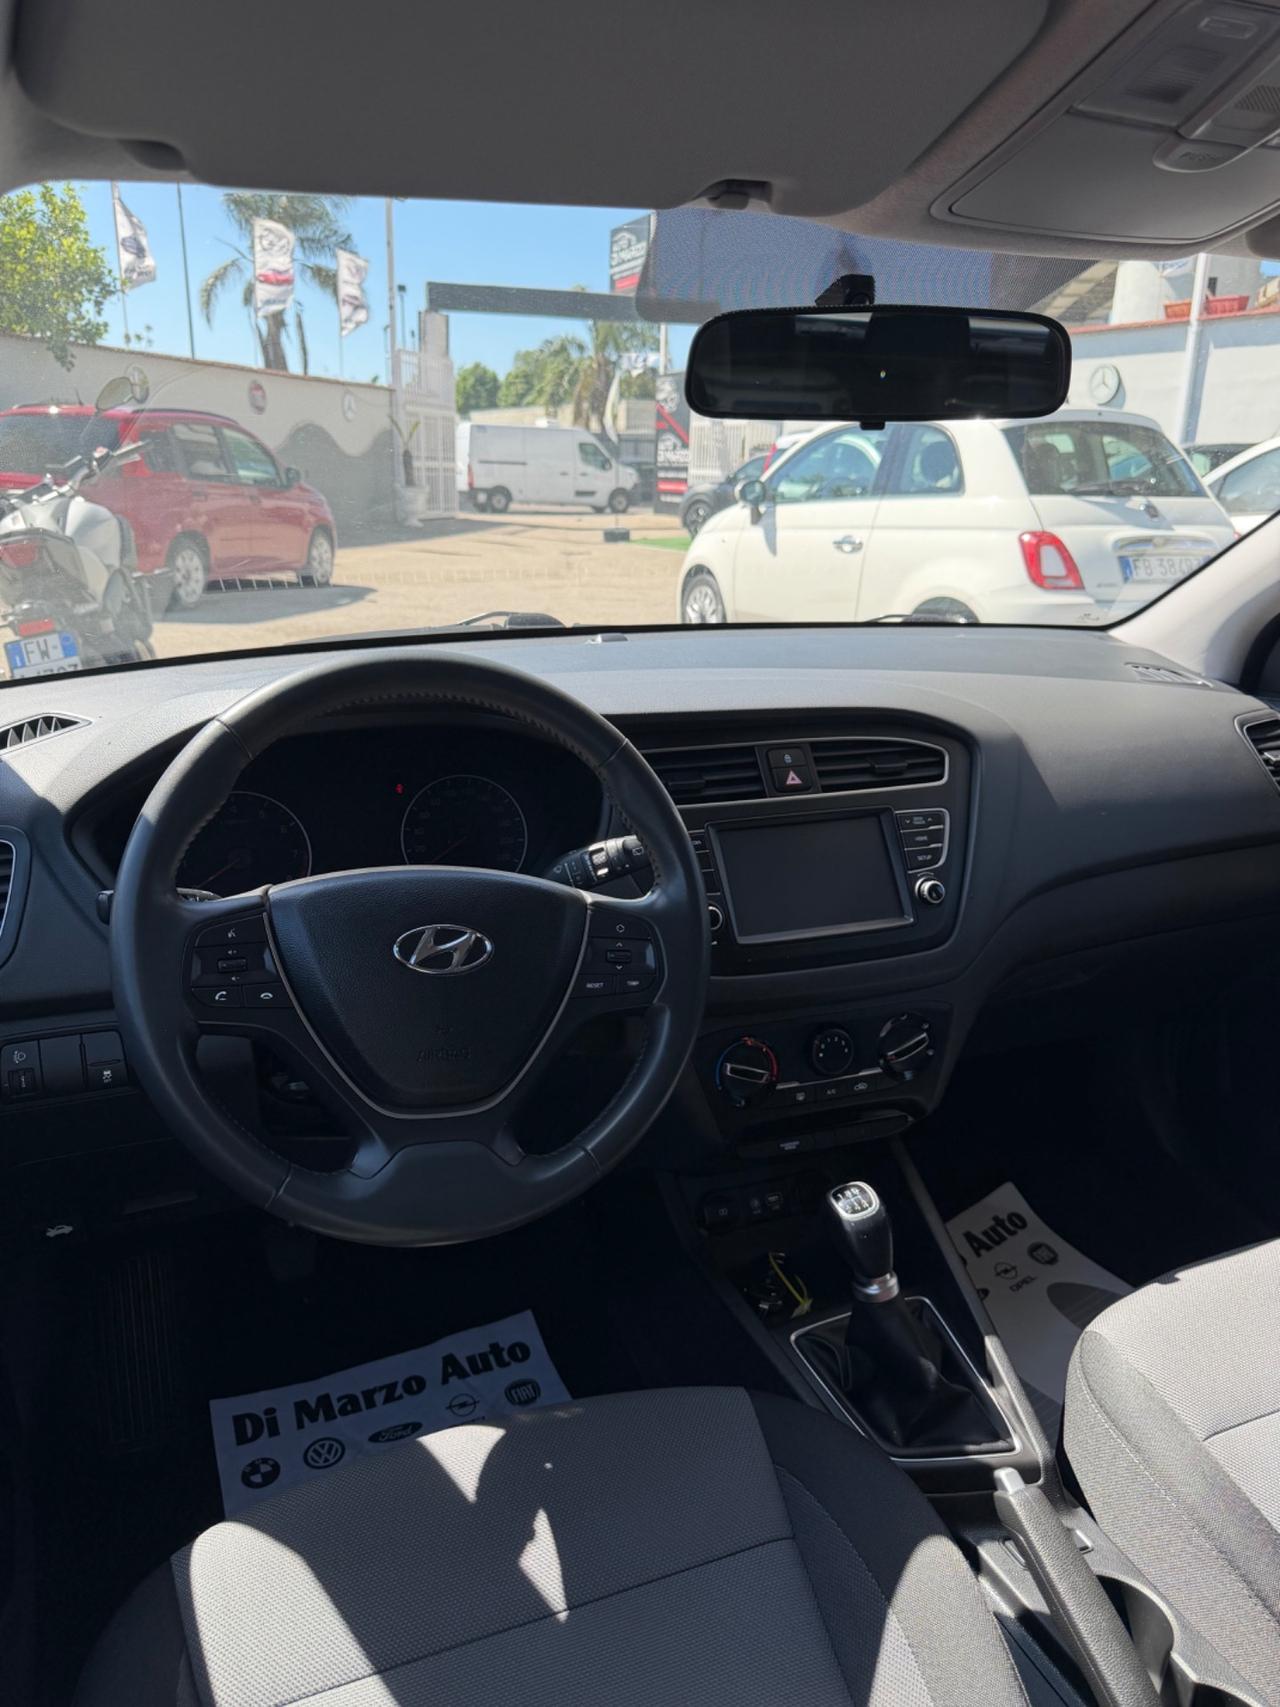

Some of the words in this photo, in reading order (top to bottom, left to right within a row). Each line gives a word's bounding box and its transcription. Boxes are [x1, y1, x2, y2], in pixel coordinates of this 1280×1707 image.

[23, 639, 51, 664] FW
[963, 1212, 1027, 1258] Auto
[232, 1407, 281, 1446] Di
[293, 1375, 426, 1430] Marzo
[441, 1342, 531, 1386] Auto
[510, 1384, 537, 1403] FIAT
